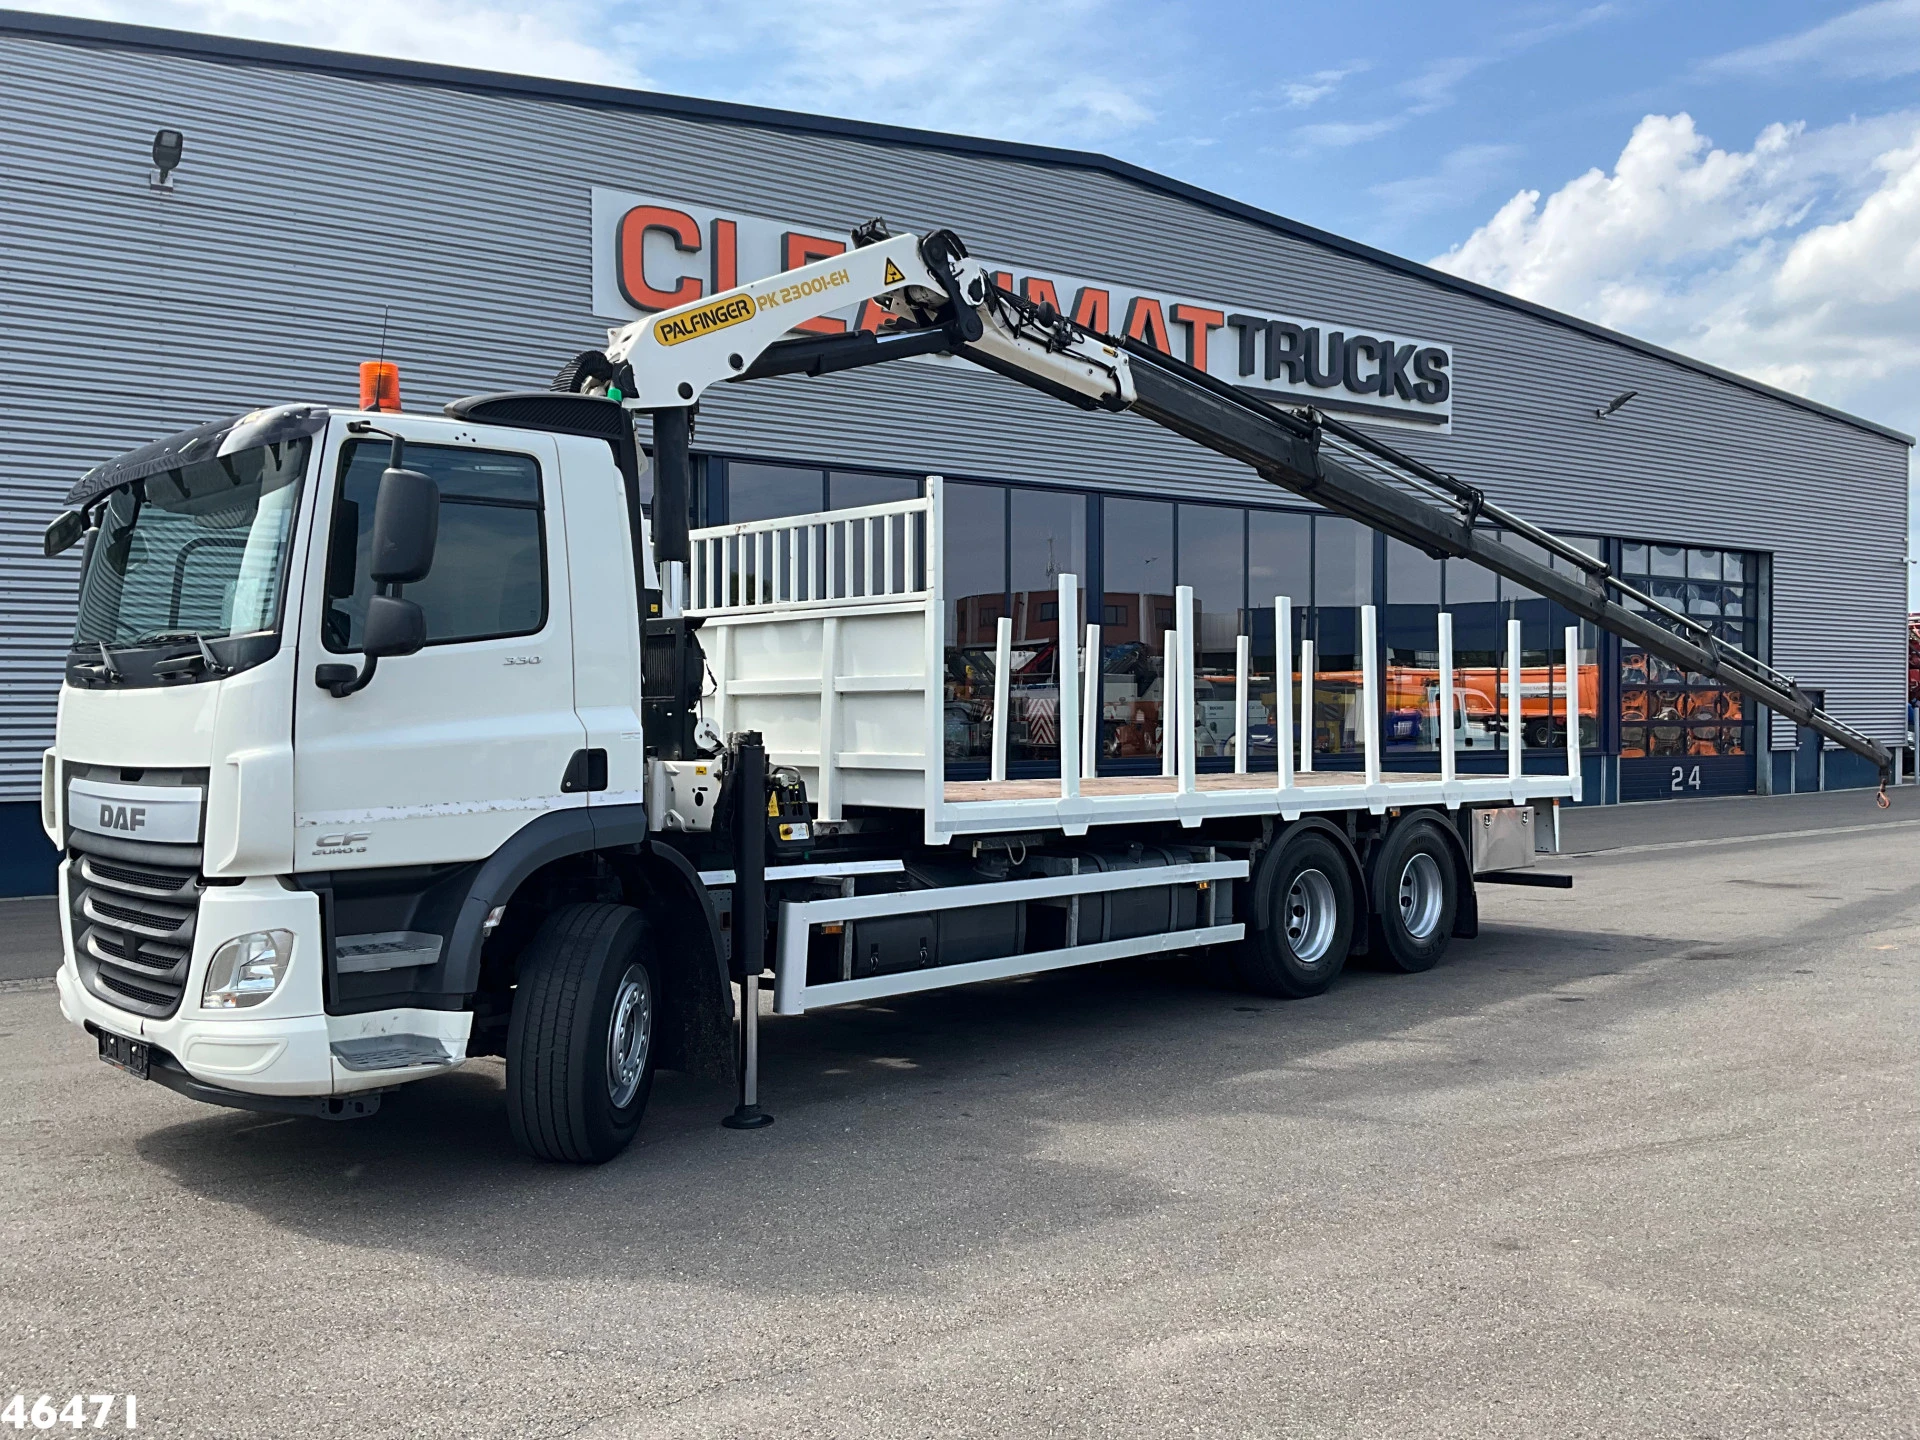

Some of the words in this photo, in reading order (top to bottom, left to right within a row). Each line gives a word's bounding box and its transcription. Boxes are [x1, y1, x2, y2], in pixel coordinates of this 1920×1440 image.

[755, 291, 783, 312] PK
[779, 269, 850, 304] 23001-EH
[659, 299, 751, 342] PALFINGER
[1228, 313, 1450, 403] TRUCKS
[502, 656, 542, 666] 330
[1671, 765, 1702, 791] 24
[99, 803, 146, 832] DAF
[315, 830, 372, 848] CF
